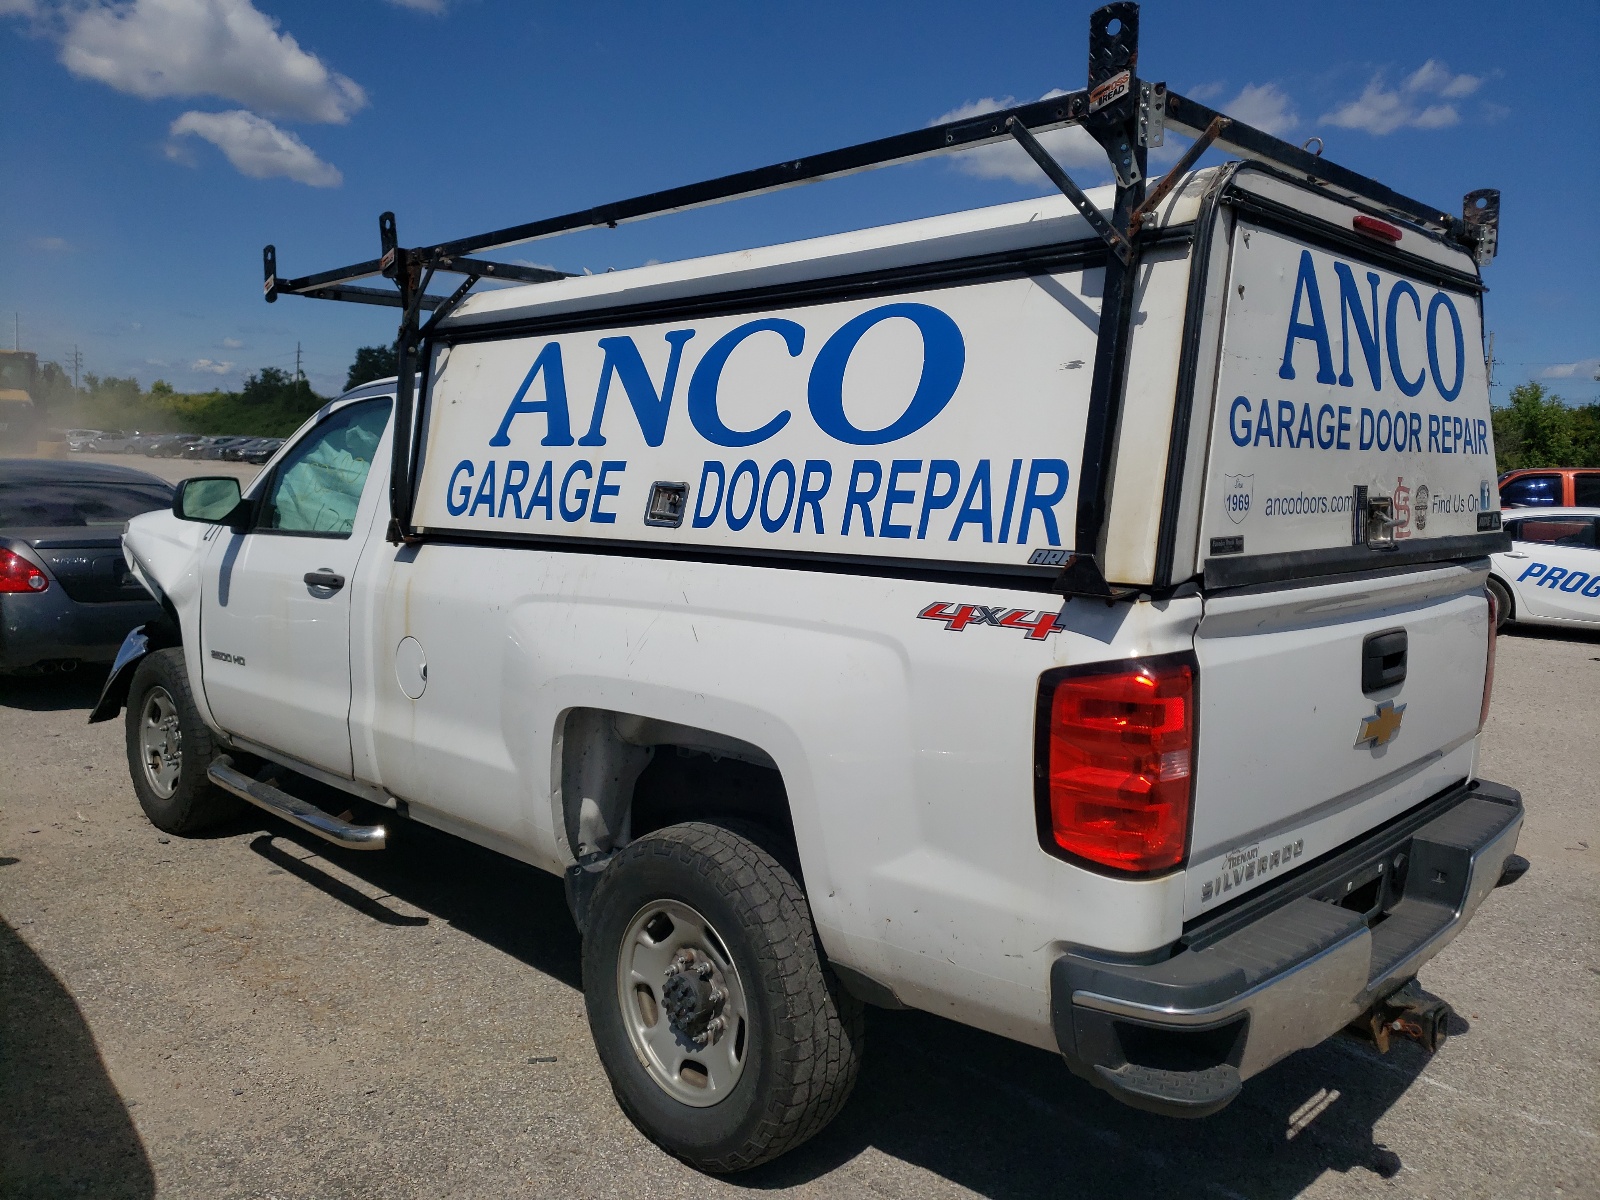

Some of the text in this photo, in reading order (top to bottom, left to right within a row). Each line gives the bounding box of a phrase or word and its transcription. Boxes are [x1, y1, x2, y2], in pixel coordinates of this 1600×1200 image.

[1279, 250, 1465, 402] ANCO
[489, 302, 966, 447] ANCO
[1230, 396, 1488, 455] GARAGE DOOR REPAIR
[446, 458, 1070, 546] GARAGE DOOR REPAIR
[1226, 493, 1250, 512] 1969
[1265, 491, 1353, 516] ancodoors.com
[1432, 493, 1479, 514] Find Us On
[1201, 838, 1304, 903] SILVERADO
